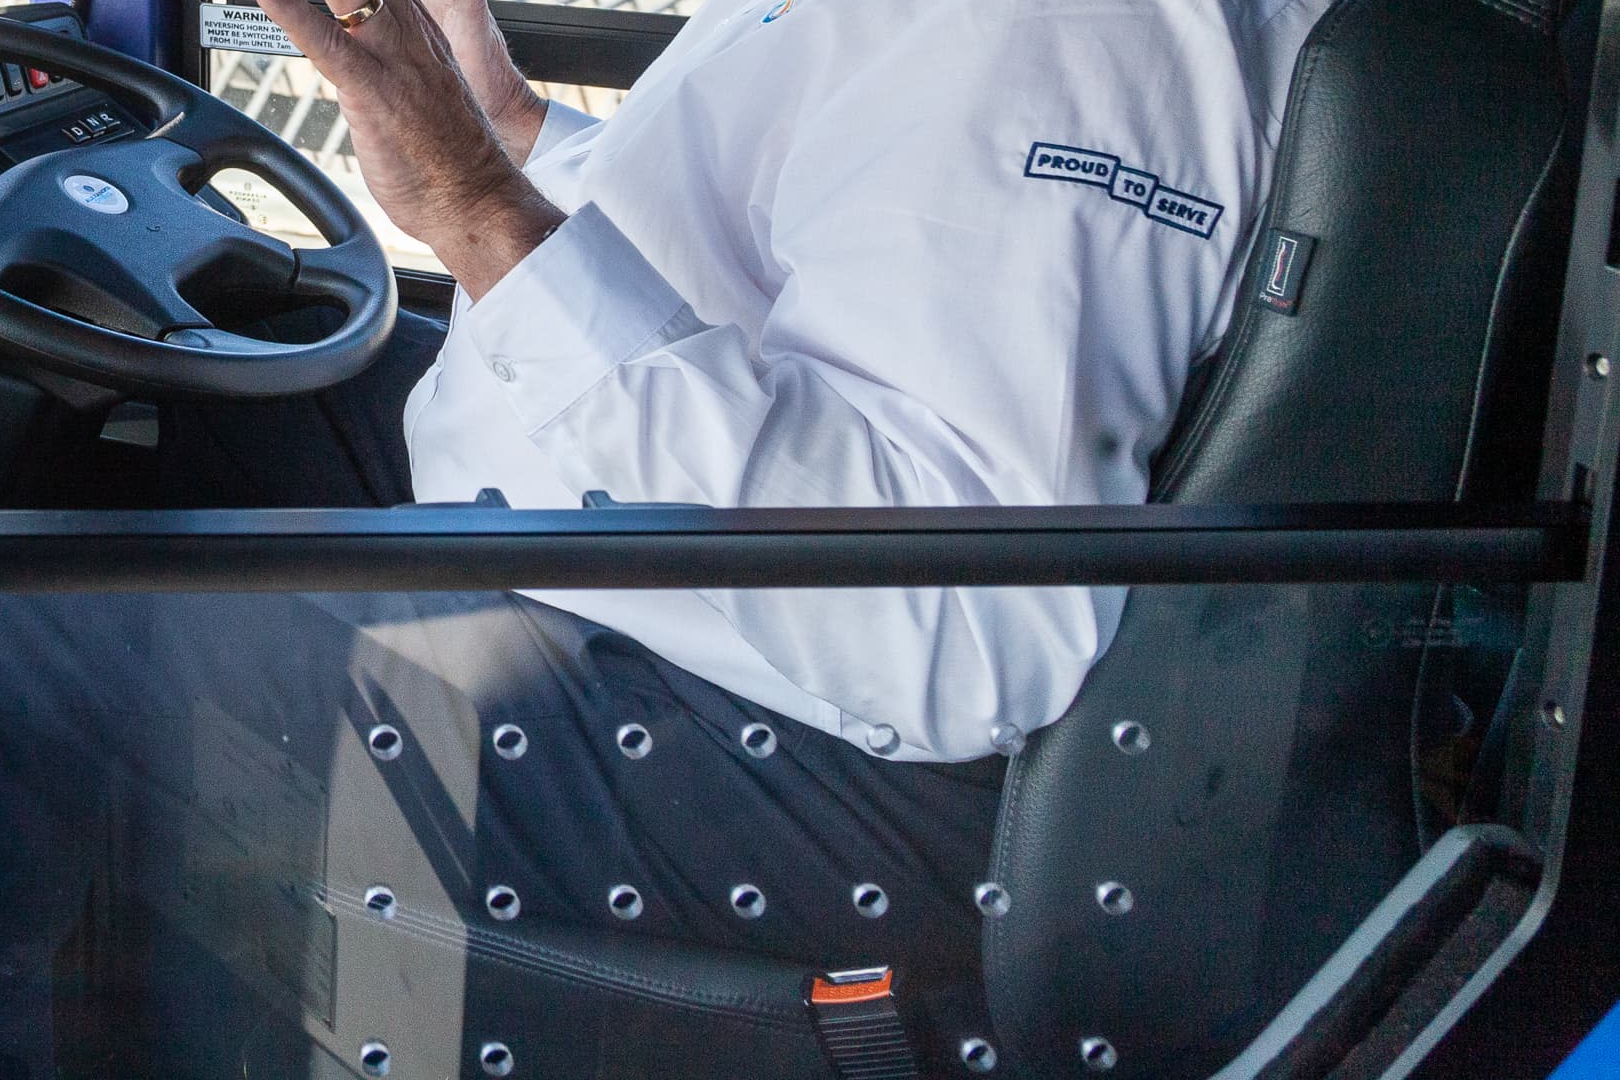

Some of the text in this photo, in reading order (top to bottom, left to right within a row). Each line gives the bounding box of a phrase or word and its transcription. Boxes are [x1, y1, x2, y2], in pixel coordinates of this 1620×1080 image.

[223, 10, 273, 22] WARNIN
[205, 21, 245, 30] REVERSING
[247, 24, 269, 32] HORN
[242, 32, 282, 41] SWITCHED
[251, 40, 274, 48] UNTIL
[277, 42, 291, 50] 7am
[71, 127, 83, 136] D
[100, 113, 114, 121] R
[1036, 153, 1208, 226] PROUD TO SERVE
